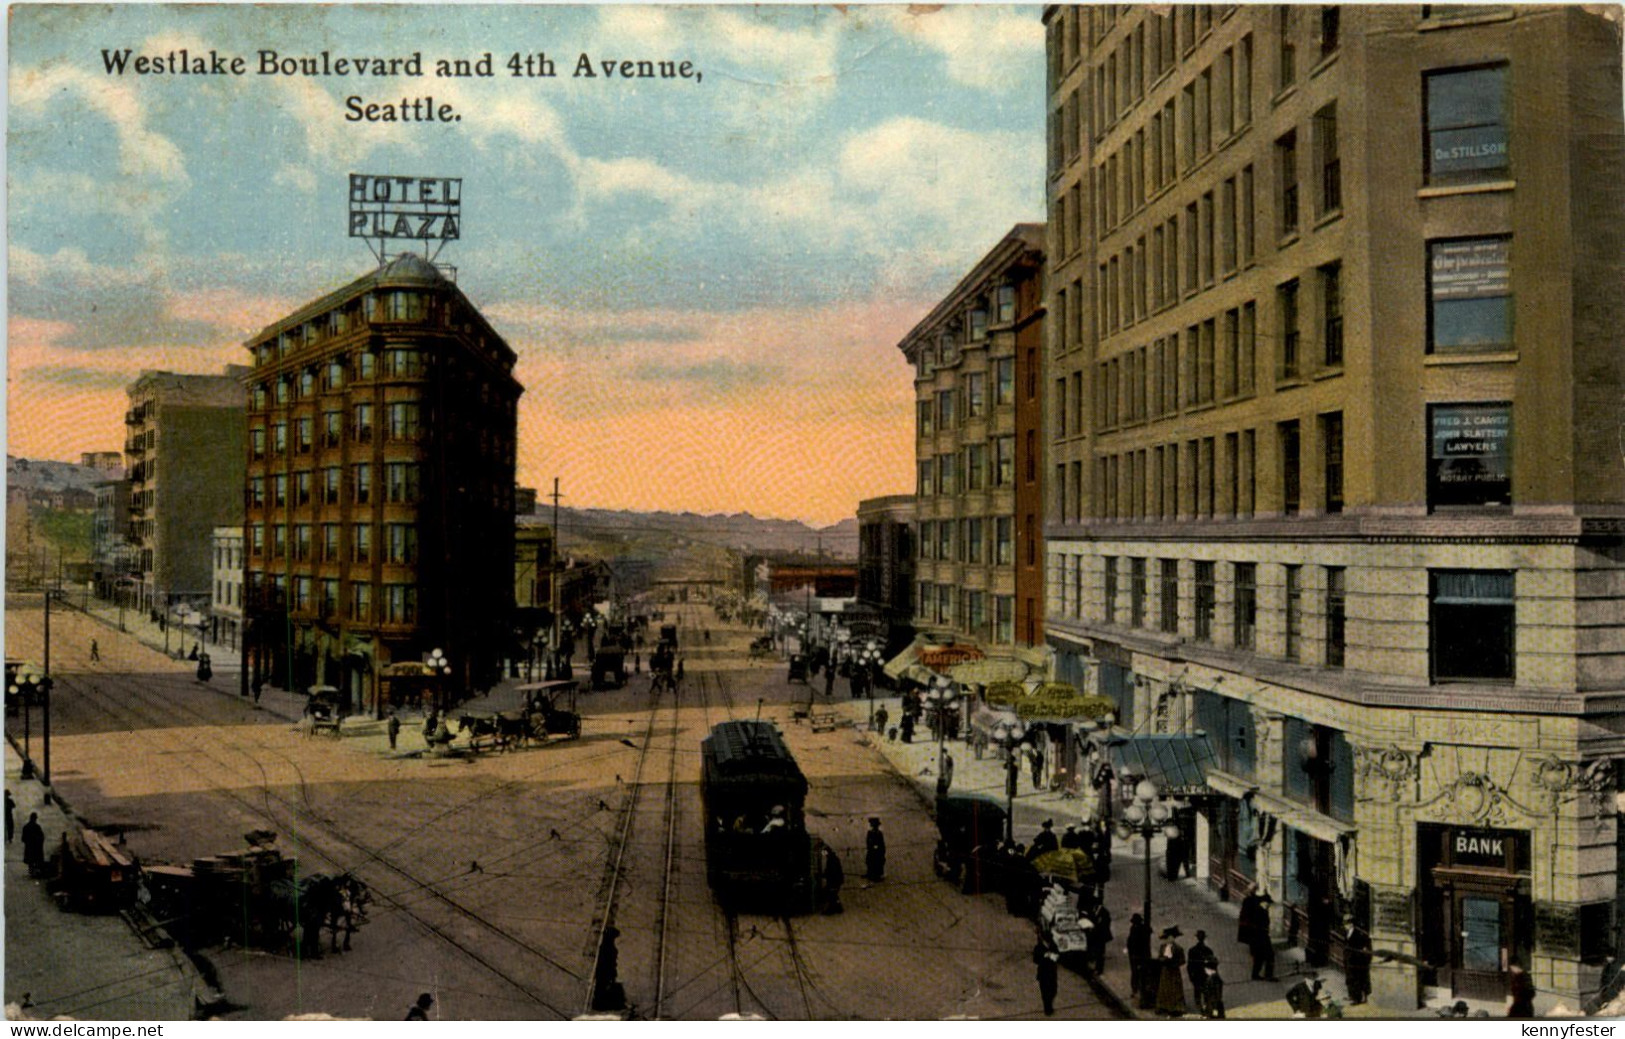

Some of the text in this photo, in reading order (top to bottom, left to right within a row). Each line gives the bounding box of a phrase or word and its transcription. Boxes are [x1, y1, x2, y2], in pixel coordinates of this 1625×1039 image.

[349, 174, 462, 206] HOTEL
[349, 211, 460, 239] PLAZA
[1446, 442, 1497, 452] LAWYERS
[1456, 836, 1503, 856] BANK
